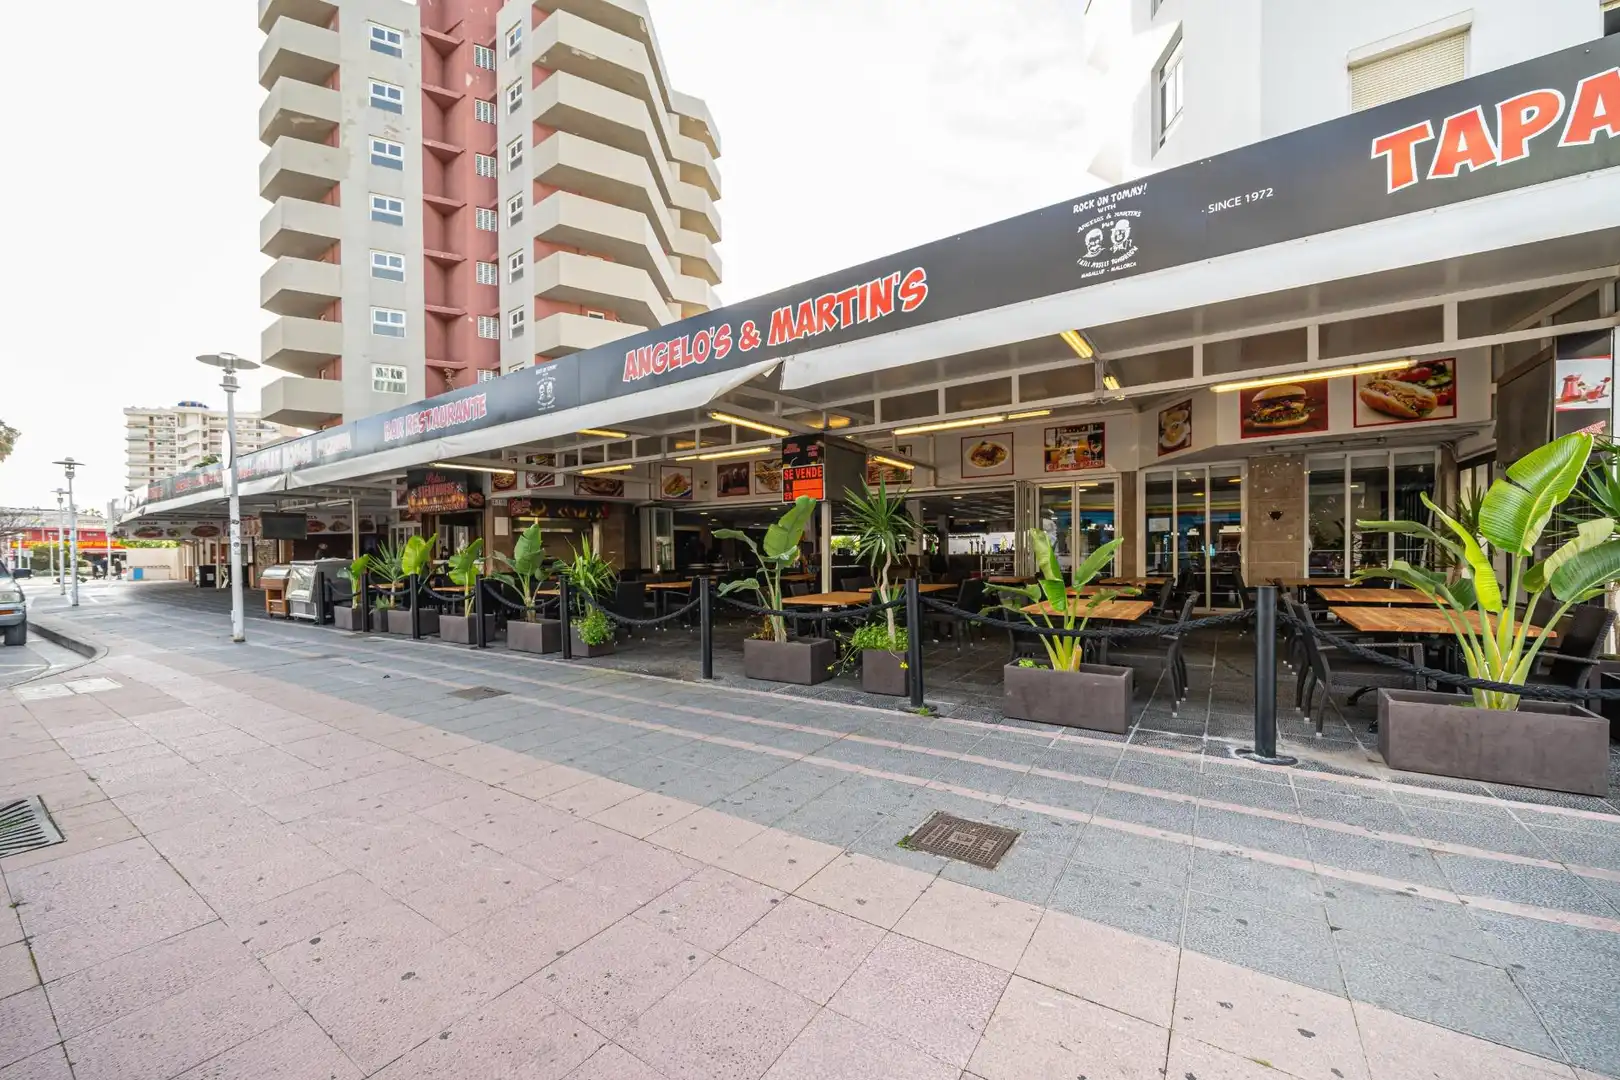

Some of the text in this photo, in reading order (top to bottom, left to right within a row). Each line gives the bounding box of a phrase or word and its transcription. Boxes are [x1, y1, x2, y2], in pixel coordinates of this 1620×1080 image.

[1073, 183, 1148, 214] ROCK ON TOMMY!
[1097, 203, 1116, 213] WITH
[1208, 187, 1274, 214] SINCE 1972
[622, 266, 929, 382] ANGELO'S & MARTIN'S
[384, 392, 488, 442] BAR RESTAURANTE
[783, 466, 822, 481] SE VENDE
